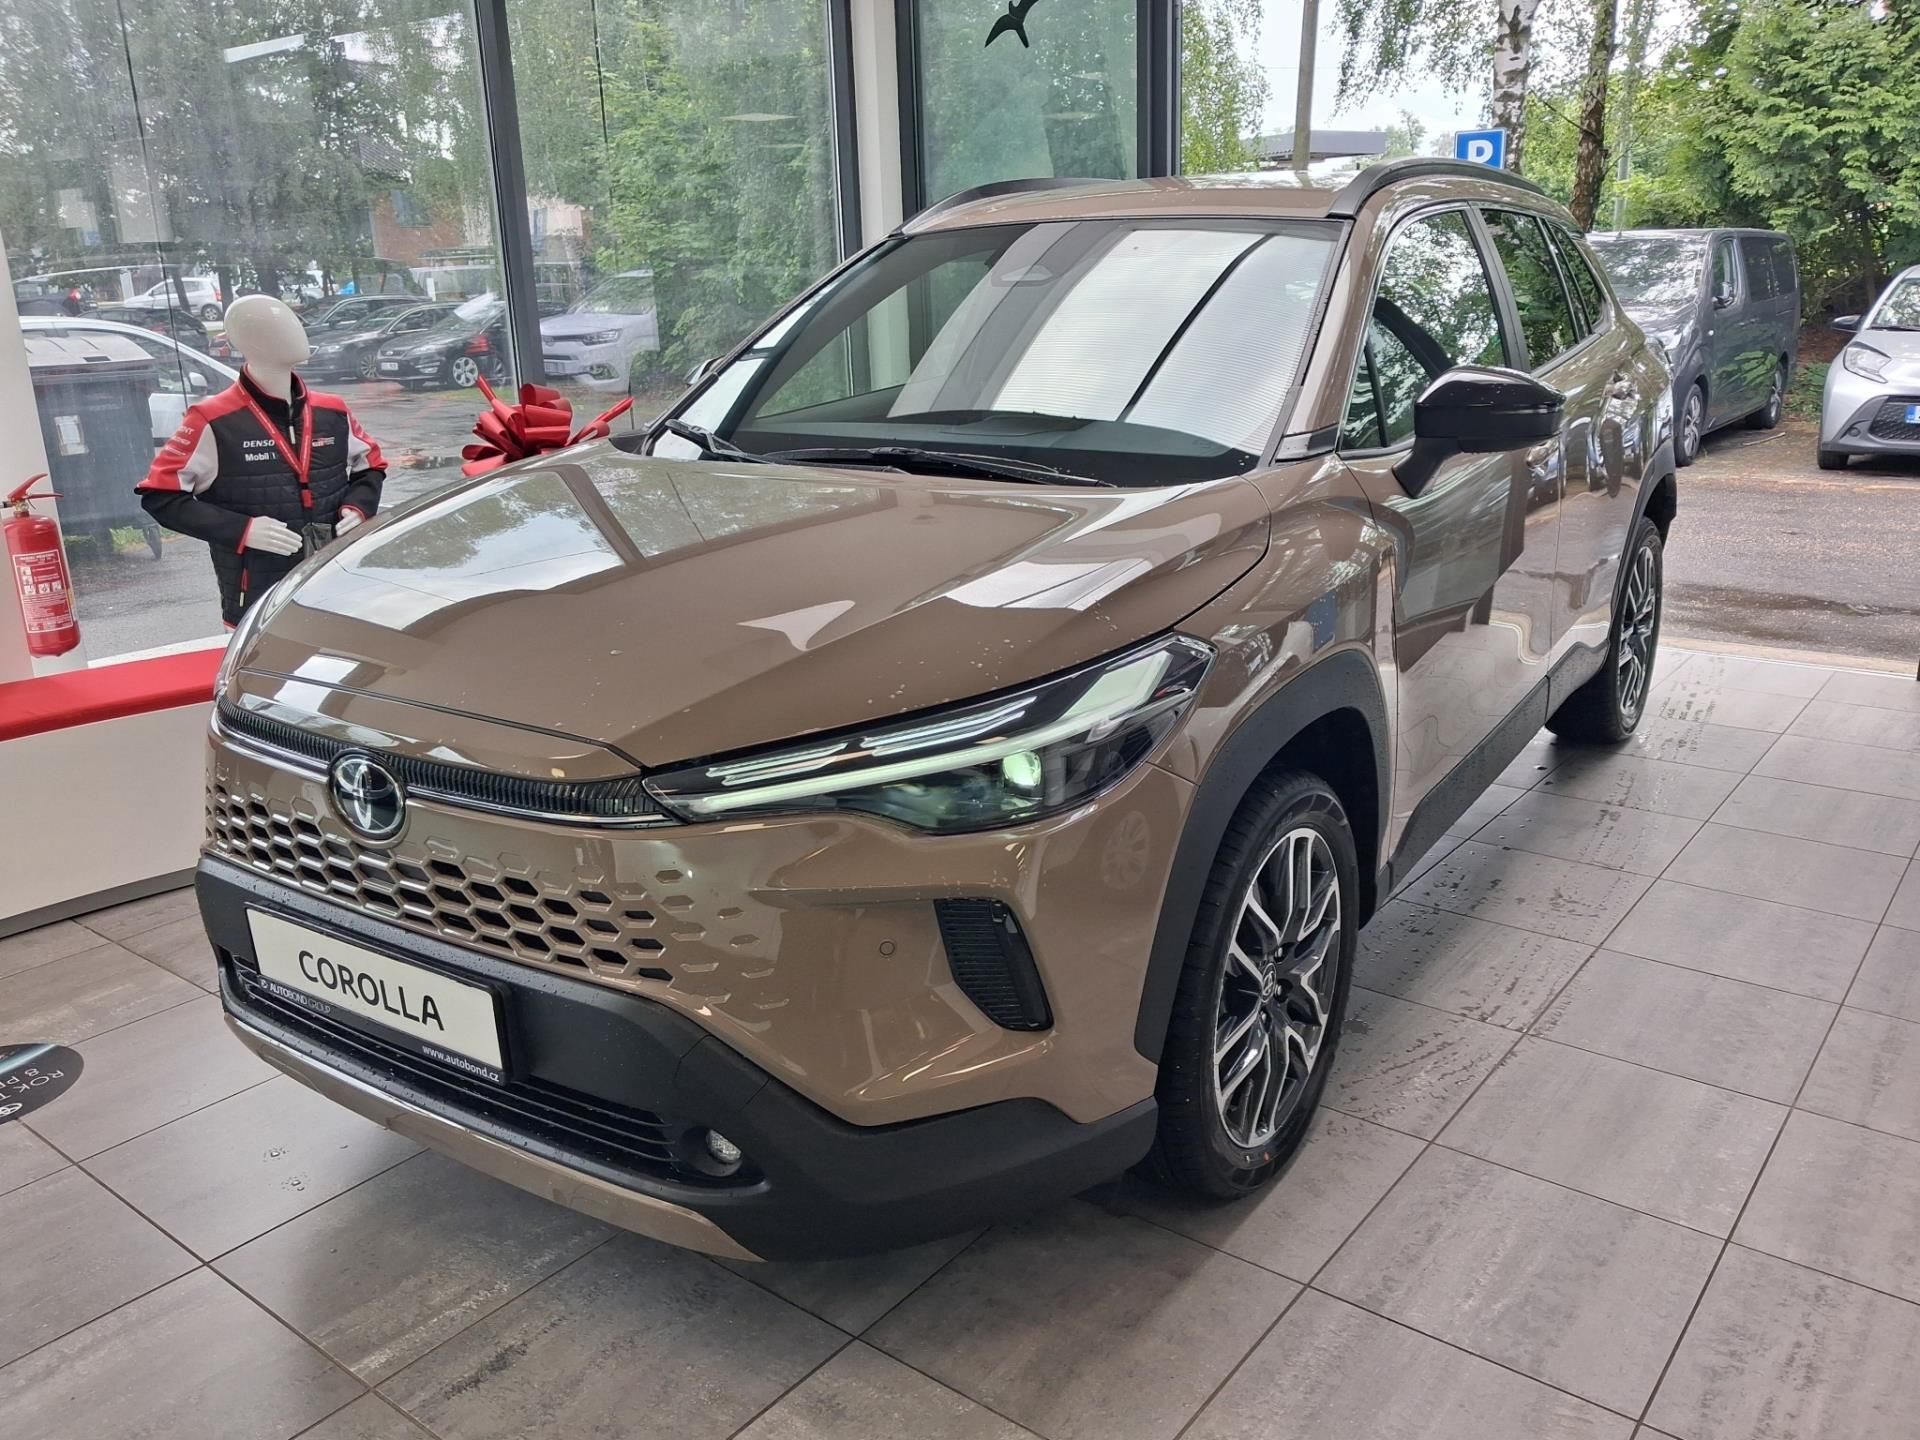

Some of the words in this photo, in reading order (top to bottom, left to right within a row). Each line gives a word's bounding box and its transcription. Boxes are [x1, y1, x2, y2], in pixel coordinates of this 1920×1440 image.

[1468, 139, 1493, 163] P
[243, 439, 275, 448] DENSO
[245, 452, 269, 461] Mobil
[269, 982, 308, 1005] AUTOBOND
[298, 950, 444, 1031] COROLLA
[422, 1045, 500, 1082] www.autobond.cz
